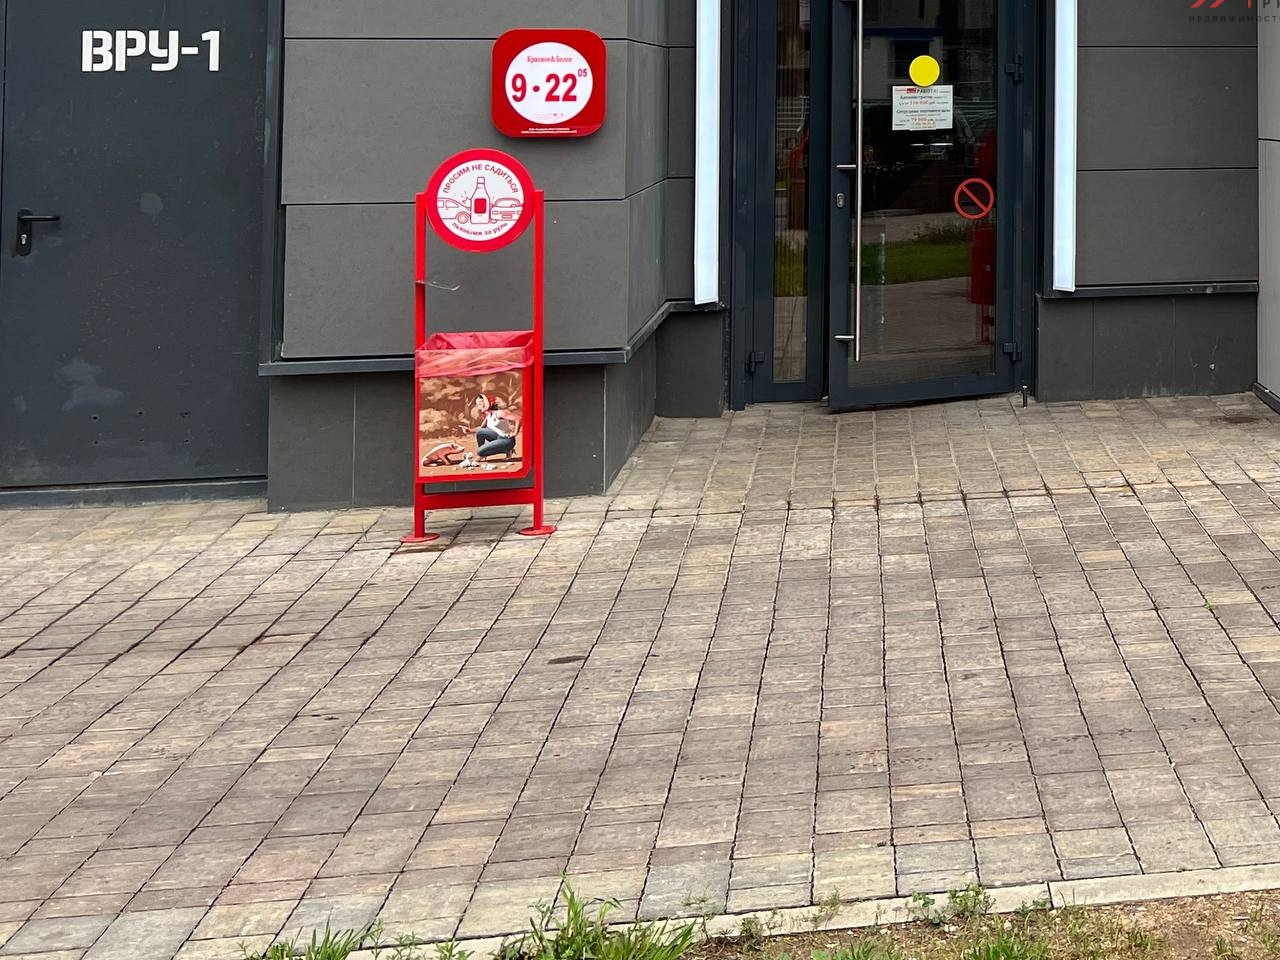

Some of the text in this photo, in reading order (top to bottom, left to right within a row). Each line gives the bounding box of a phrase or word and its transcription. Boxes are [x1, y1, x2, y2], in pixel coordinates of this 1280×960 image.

[81, 29, 221, 72] ВРУ-1
[442, 166, 470, 194] ПРОСИМ
[484, 164, 519, 194] САДИТЬСЯ
[493, 222, 508, 235] руль
